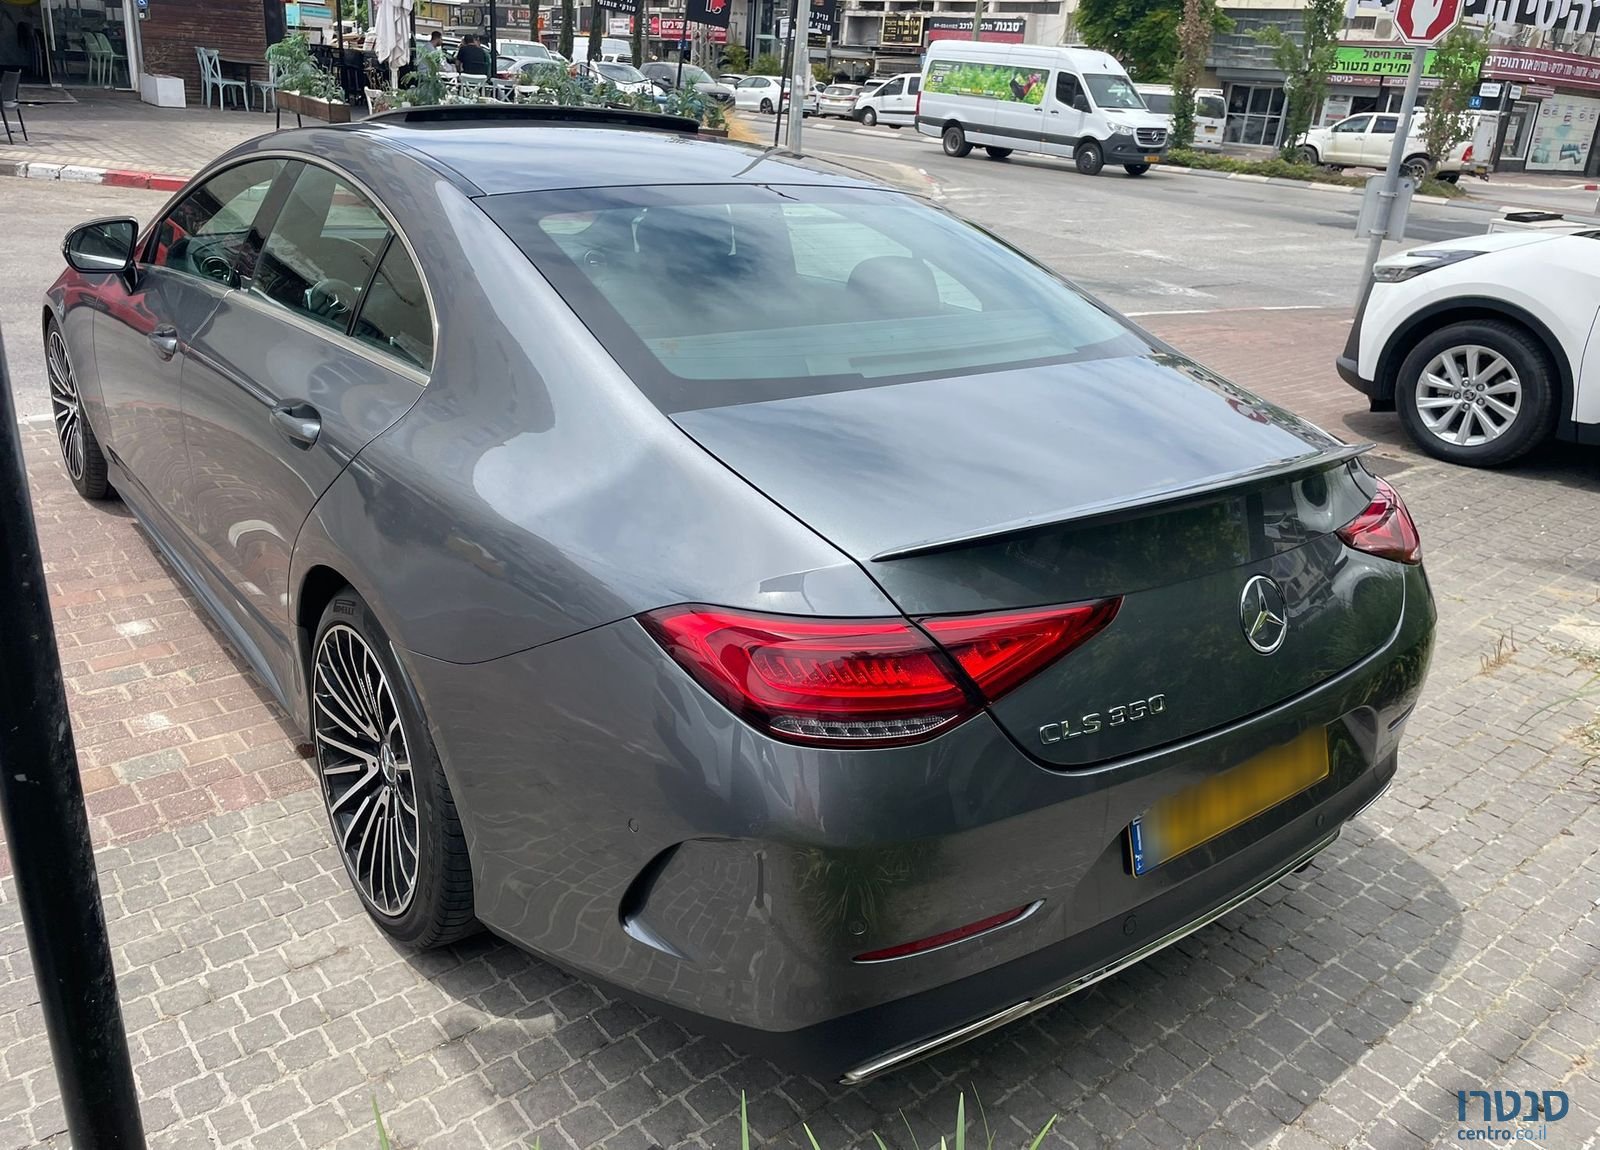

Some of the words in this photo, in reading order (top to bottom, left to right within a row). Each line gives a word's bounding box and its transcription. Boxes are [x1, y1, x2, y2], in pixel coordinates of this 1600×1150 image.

[1363, 50, 1391, 59] חיסול
[1471, 98, 1481, 106] 14
[1039, 712, 1101, 745] CLS
[1108, 693, 1166, 726] 350
